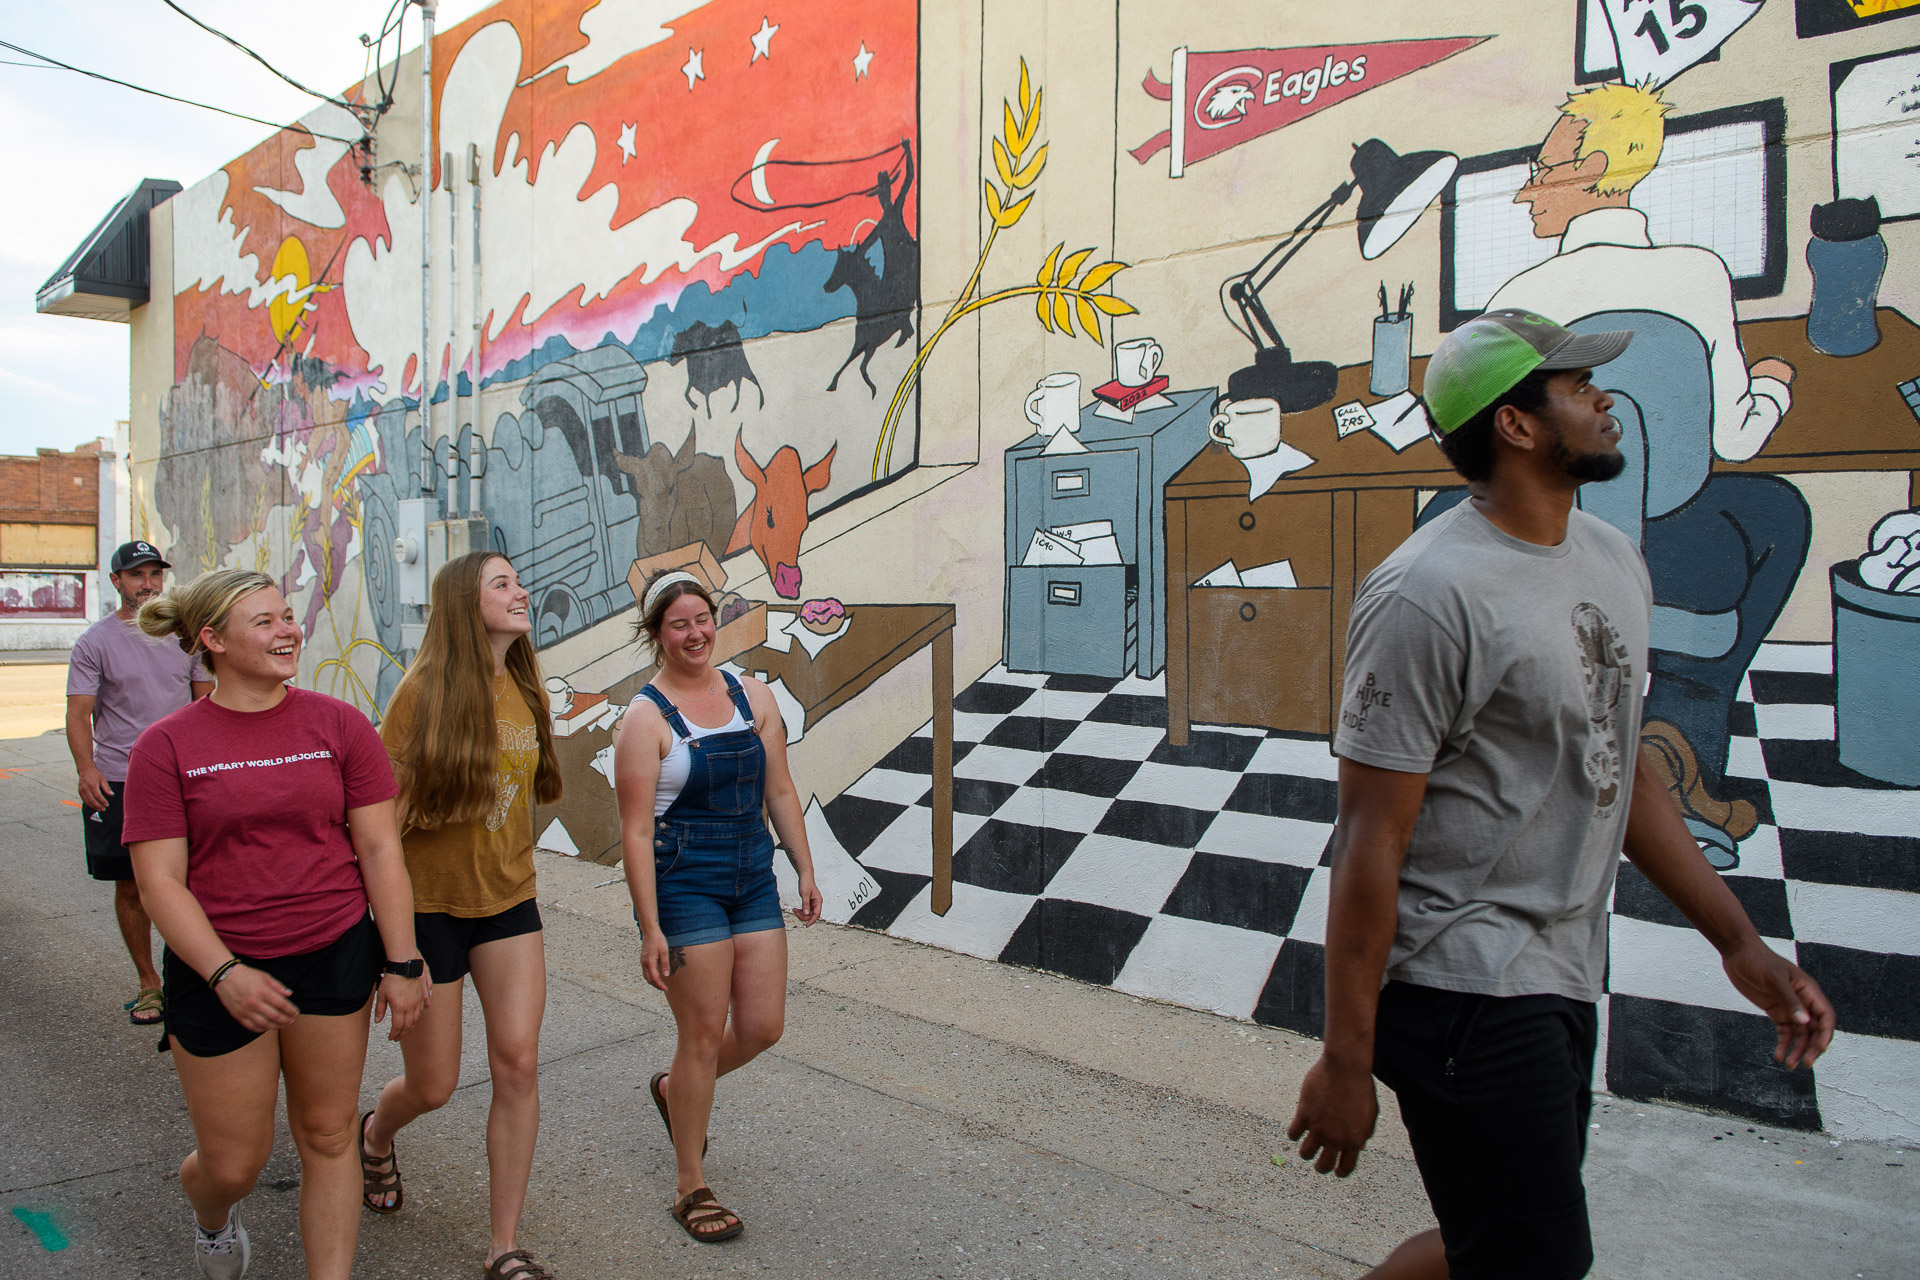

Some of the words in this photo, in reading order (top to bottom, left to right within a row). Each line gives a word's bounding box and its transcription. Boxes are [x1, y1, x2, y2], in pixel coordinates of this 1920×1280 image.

[1634, 0, 1707, 55] 15
[1263, 54, 1367, 104] Eagles
[1123, 389, 1148, 407] 2022
[1356, 684, 1393, 707] HIKE
[186, 766, 207, 778] THE
[207, 761, 245, 774] WEARY
[246, 757, 284, 768] WORLD
